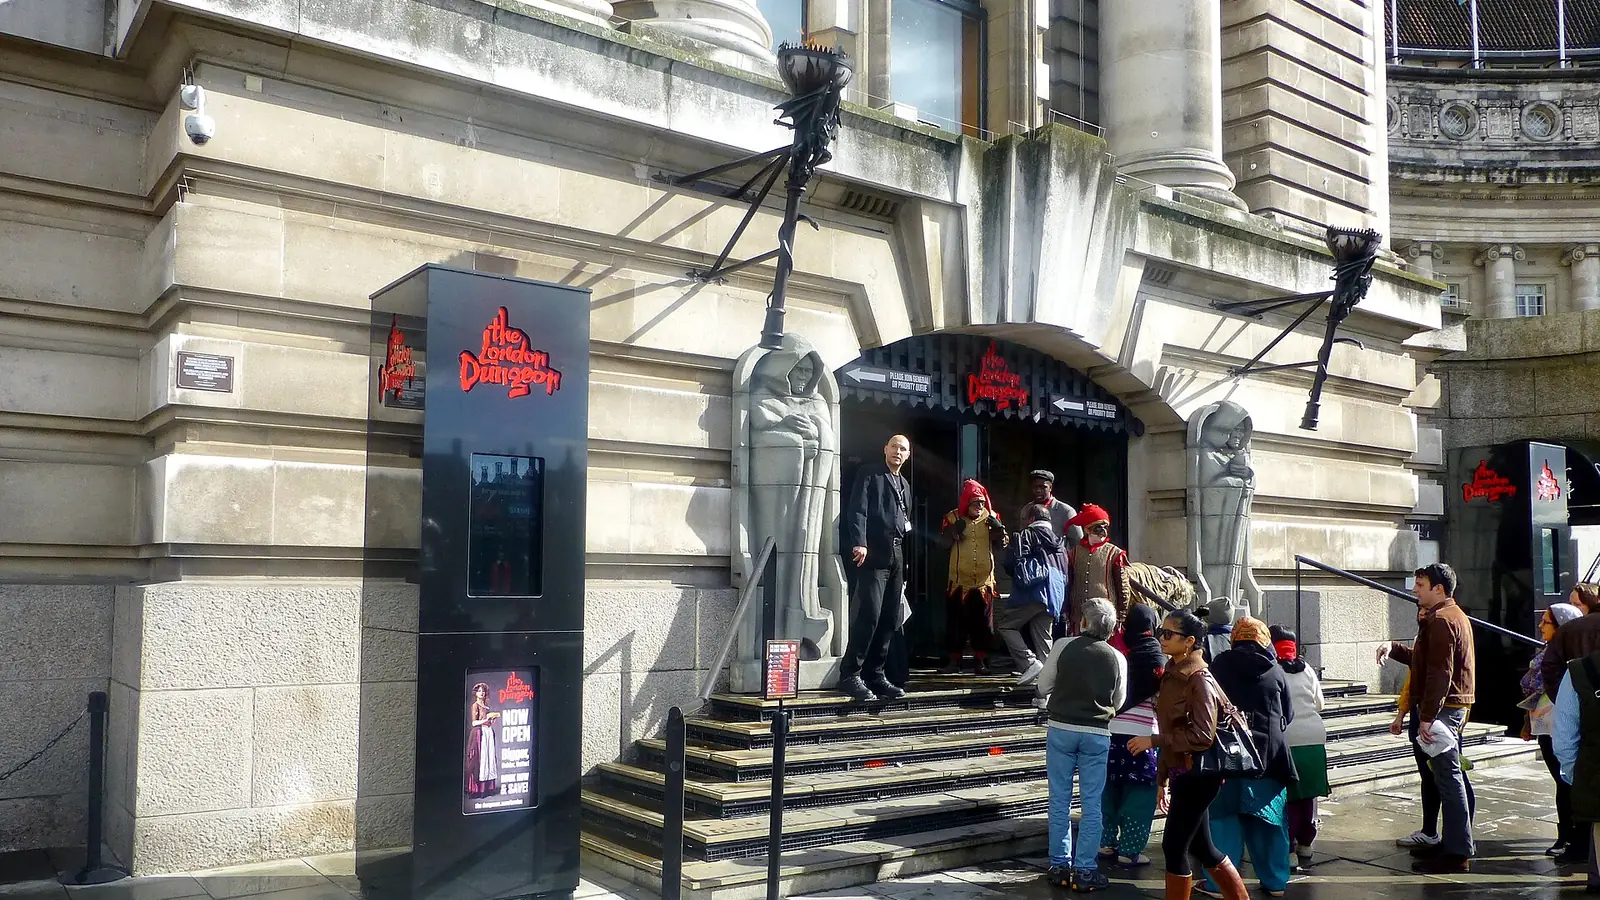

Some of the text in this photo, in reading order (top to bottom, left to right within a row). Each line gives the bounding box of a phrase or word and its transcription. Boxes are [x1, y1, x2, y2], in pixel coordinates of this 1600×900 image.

[487, 306, 522, 346] the
[478, 329, 549, 369] London
[459, 351, 561, 399] Dungeon
[889, 371, 904, 381] PLEASE
[912, 375, 929, 385] GENERAL
[898, 381, 915, 391] PRIORITY
[915, 383, 928, 392] QUEUE
[502, 708, 529, 726] NOW
[502, 725, 531, 743] OPEN
[500, 783, 507, 795] &
